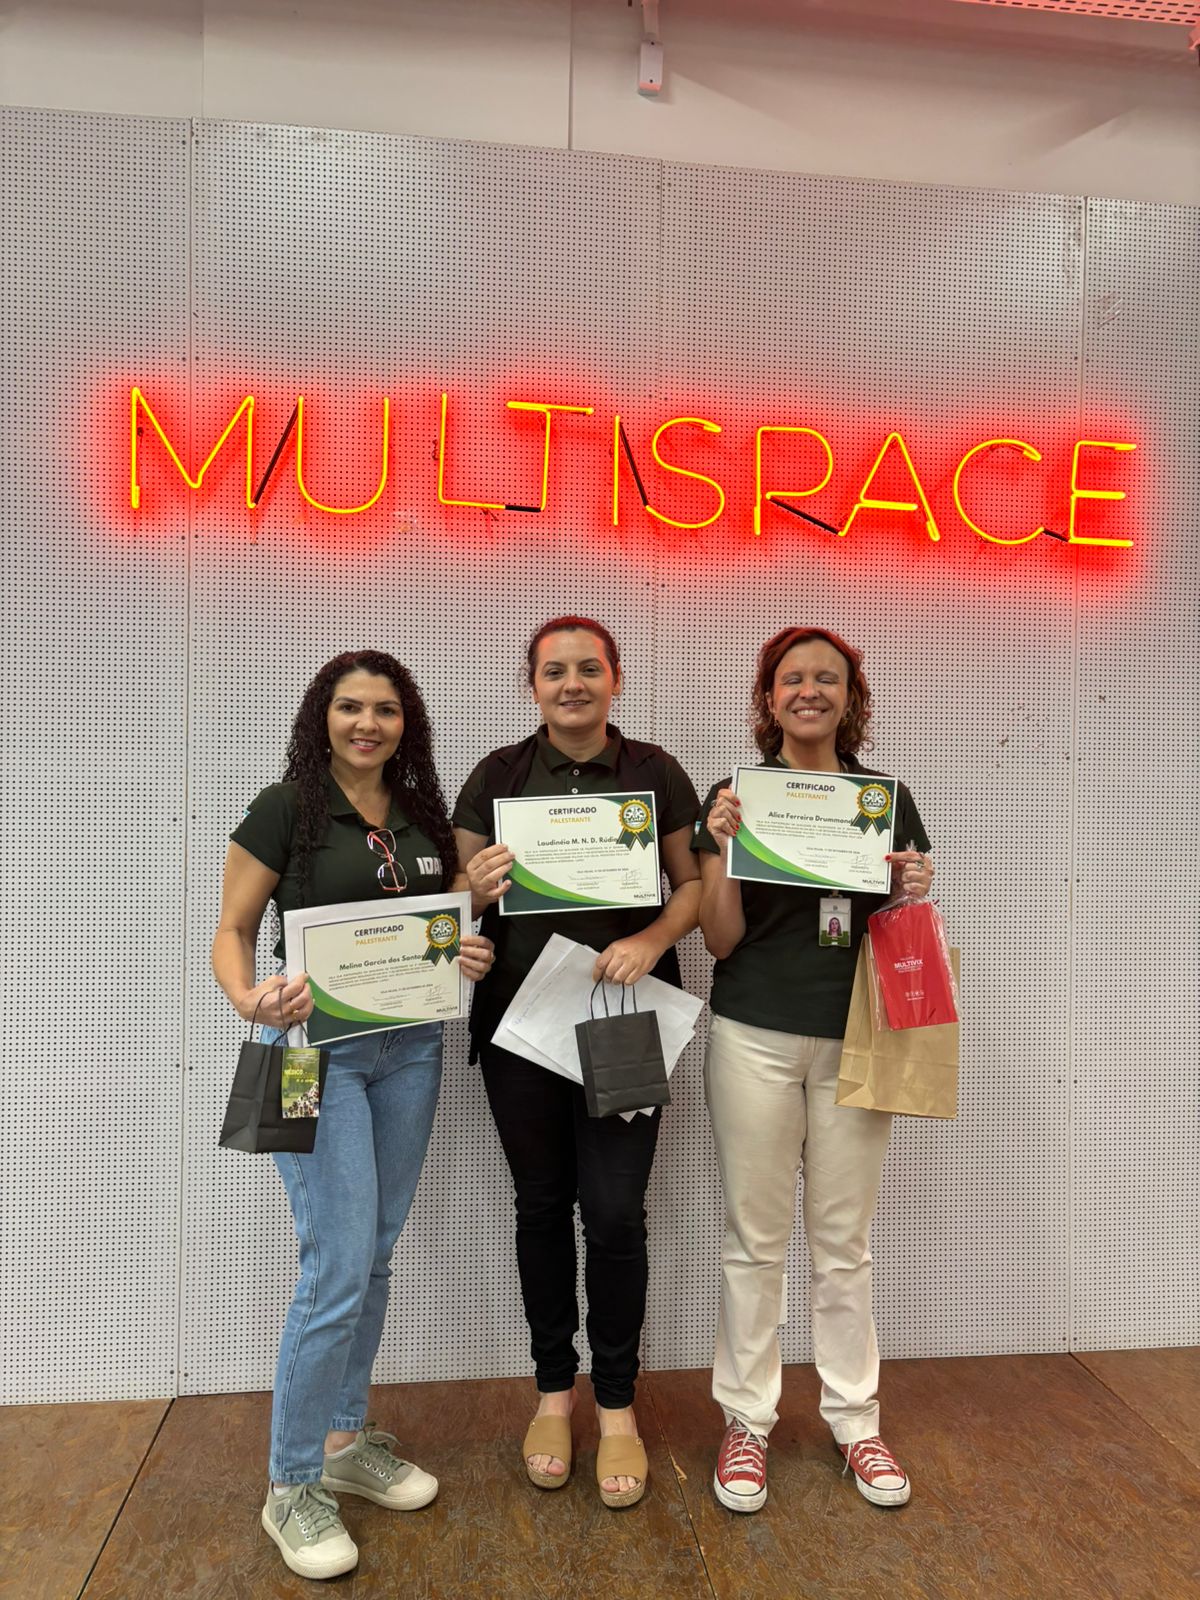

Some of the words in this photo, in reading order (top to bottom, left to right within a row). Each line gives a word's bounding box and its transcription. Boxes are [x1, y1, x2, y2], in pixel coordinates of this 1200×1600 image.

[130, 386, 1137, 548] MULTISPACE
[786, 781, 836, 792] CERTIFICADO
[786, 791, 828, 801] PALESTRANTE
[548, 806, 597, 815] CERTIFICADO
[550, 816, 591, 824] PALESTRANTE
[768, 811, 785, 819] Alice
[786, 812, 814, 821] Ferreira
[354, 924, 404, 937] CERTIFICADO
[355, 935, 398, 946] PALESTRANTE
[339, 963, 363, 971] Melina
[363, 958, 387, 967] Garcia
[388, 956, 400, 964] dos
[894, 959, 924, 969] MULTIVIX
